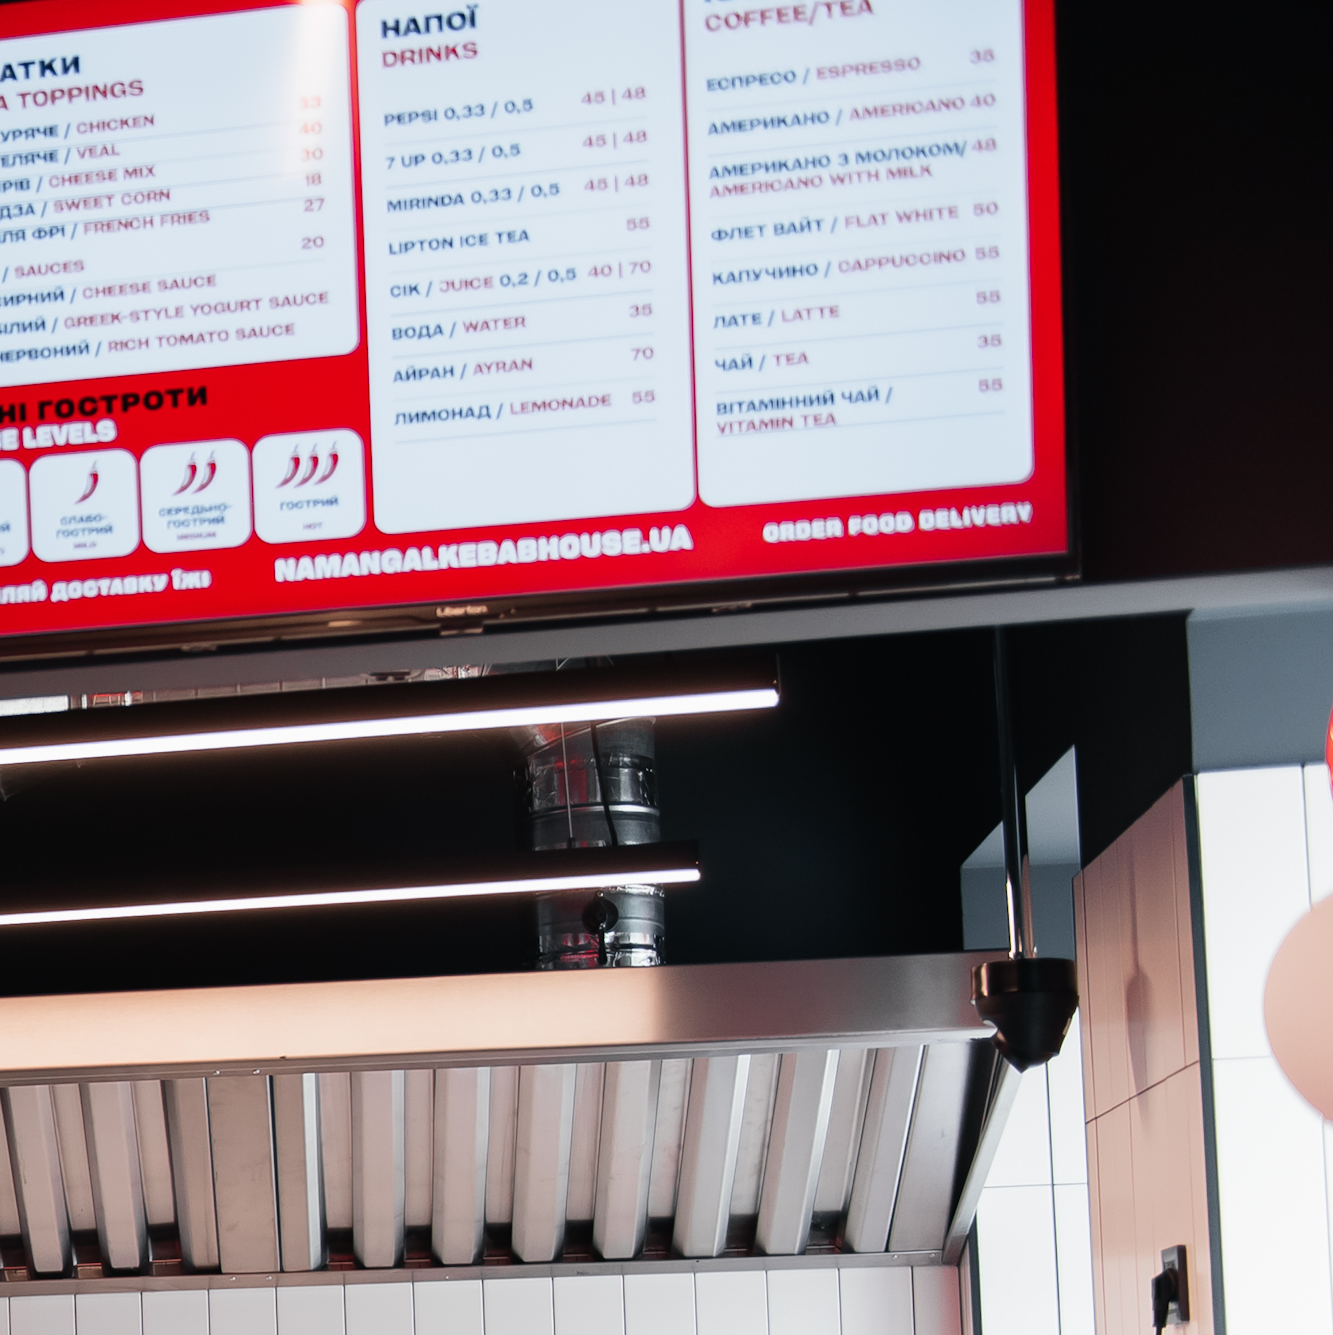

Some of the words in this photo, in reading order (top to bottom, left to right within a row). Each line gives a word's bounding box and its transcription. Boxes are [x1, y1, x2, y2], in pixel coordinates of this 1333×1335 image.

[382, 3, 477, 39] НАПОЇ
[704, 0, 874, 32] COFFEE/TEA
[383, 42, 478, 67] DRINKS
[18, 81, 143, 112] TOPPINGS
[384, 109, 438, 126] PEPSI
[444, 103, 484, 121] 0,33
[505, 99, 533, 115] 0,5
[710, 176, 822, 198] AMERICANO
[831, 170, 879, 185] WITH
[886, 165, 932, 180] MILK
[389, 236, 453, 255] LIPTON
[460, 232, 488, 248] ICE
[496, 230, 529, 244] TEA
[83, 281, 152, 299] CHEESE
[158, 274, 216, 291] SAUCE
[190, 298, 263, 317] YOGURT
[269, 292, 328, 309] SAUCE
[714, 312, 762, 328] ЛАТЕ
[781, 305, 840, 322] LATTE
[108, 336, 149, 352] RICH
[157, 330, 229, 348] TOMATO
[236, 323, 295, 340] SAUCE
[393, 364, 454, 383] АЙРАН
[473, 358, 533, 376] AYRAN
[631, 347, 654, 361] 70
[38, 387, 207, 420] ГОСТРОТИ
[395, 404, 491, 425] ЛИМОНАД
[510, 394, 611, 415] LEMONADE
[23, 419, 116, 449] LEVELS
[717, 417, 794, 434] VITAMIN
[802, 412, 836, 428] TEA
[763, 516, 843, 543] ORDER
[849, 509, 912, 536] FOOD
[920, 502, 1033, 532] DELIVERY
[275, 525, 692, 582] NAMANGALKEBABHOUSE.UA
